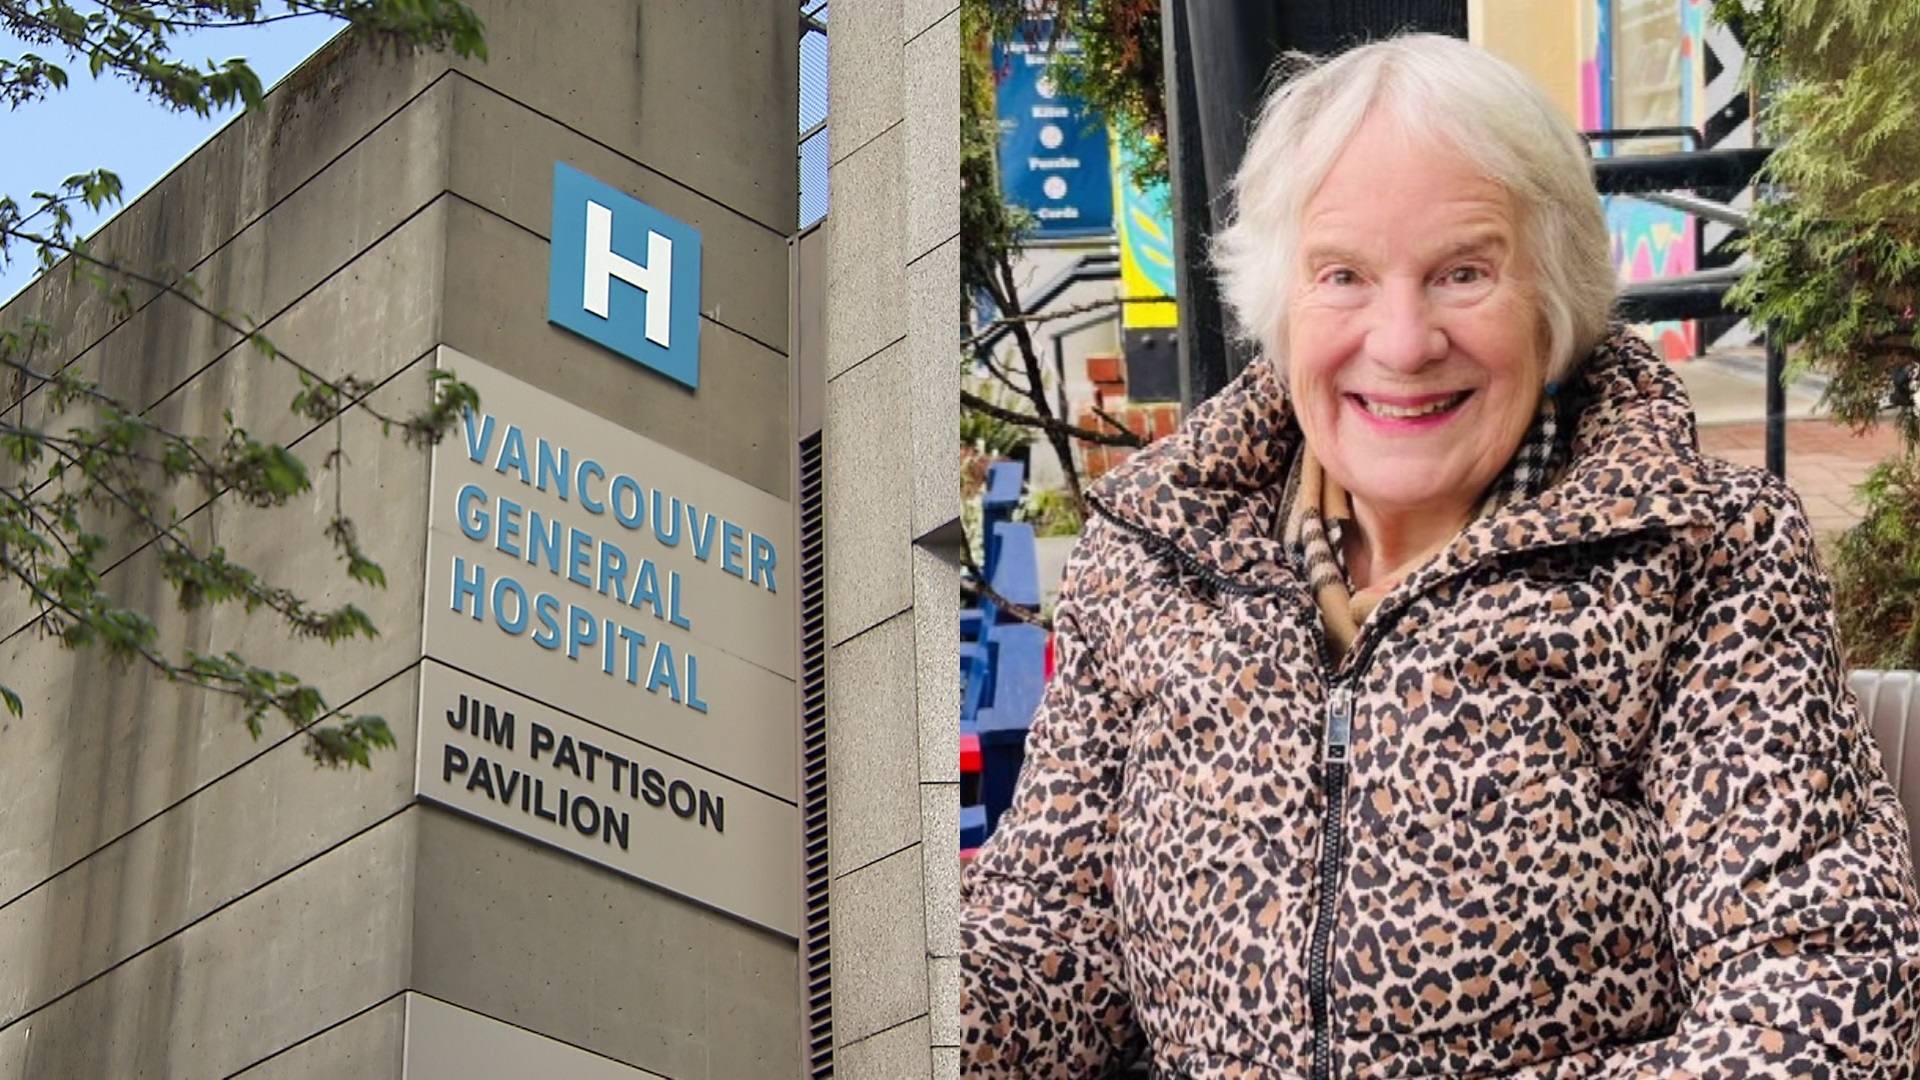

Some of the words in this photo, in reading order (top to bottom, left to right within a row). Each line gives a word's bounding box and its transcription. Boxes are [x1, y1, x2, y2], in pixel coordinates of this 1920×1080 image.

[583, 199, 673, 350] H
[455, 484, 692, 631] GENERAL
[462, 404, 778, 594] VANCOUVER
[450, 555, 709, 714] HOSPITAL
[443, 743, 629, 850] PAVILION
[446, 694, 516, 750] JIM
[530, 722, 725, 833] PATTISON
